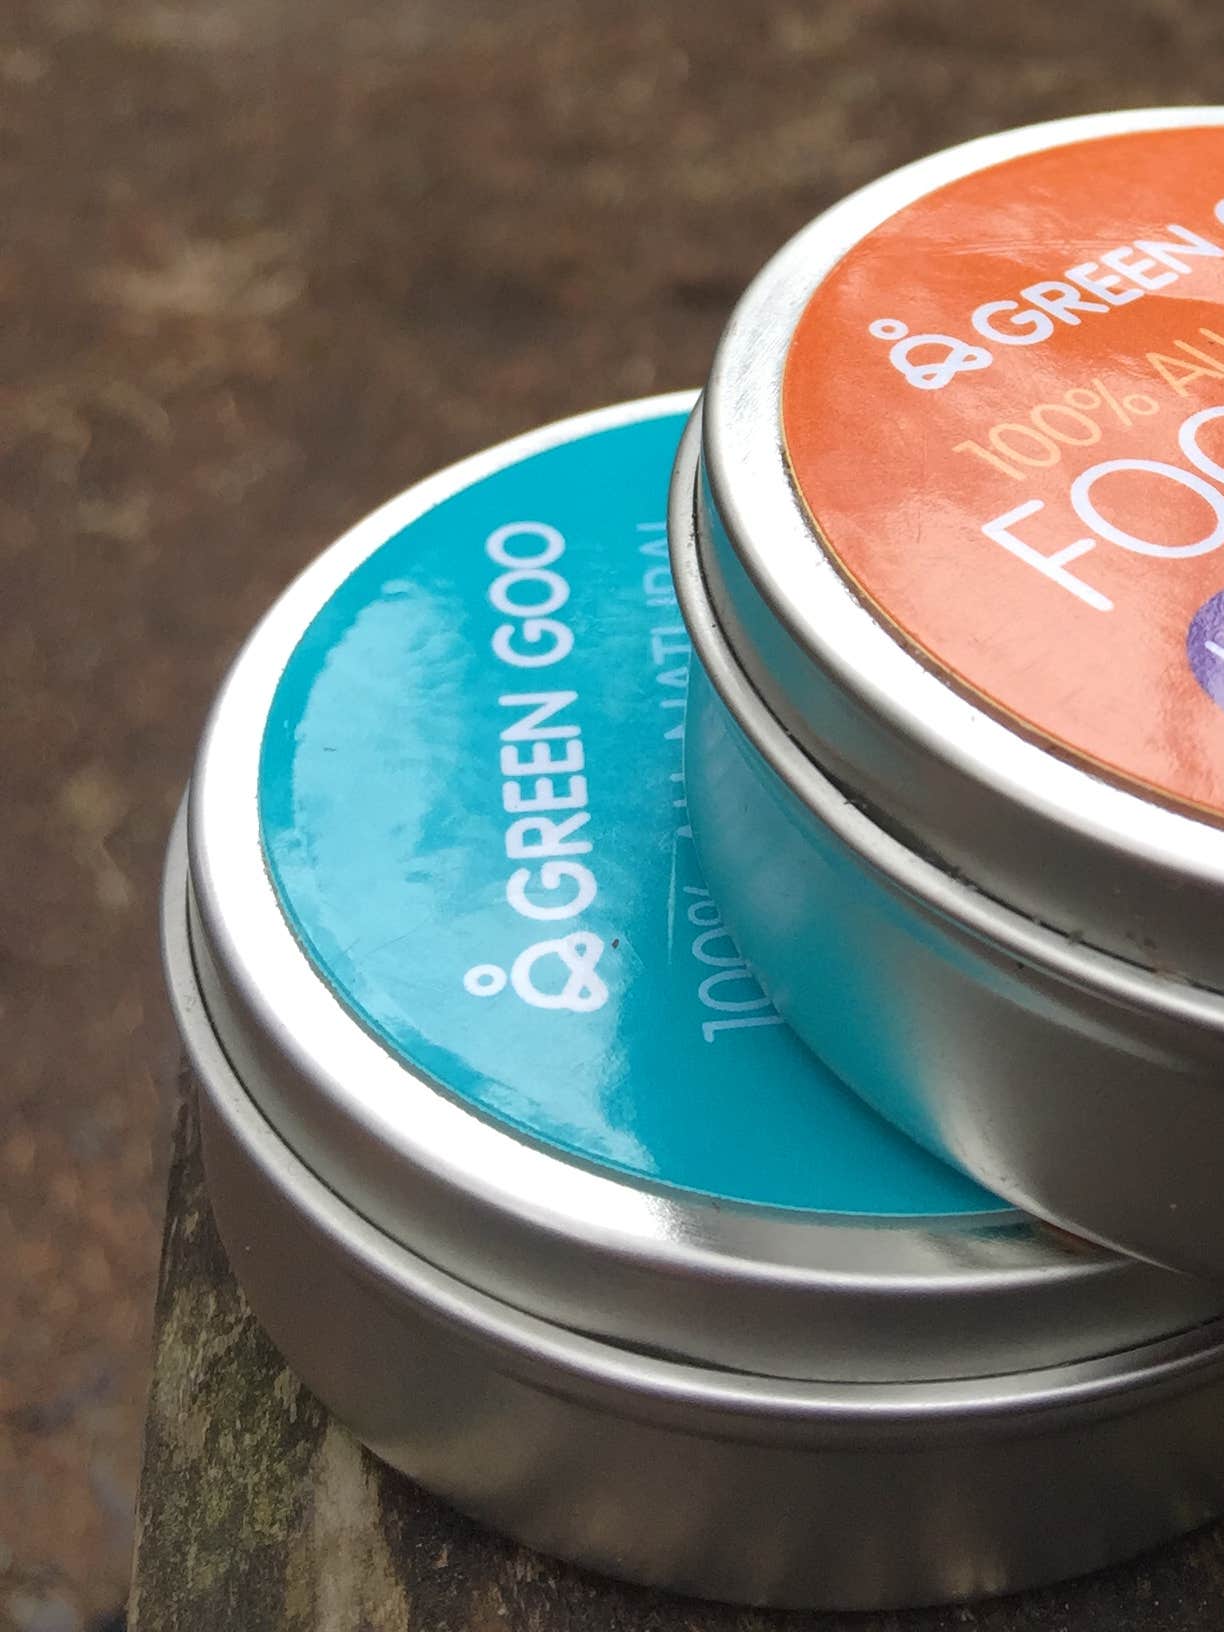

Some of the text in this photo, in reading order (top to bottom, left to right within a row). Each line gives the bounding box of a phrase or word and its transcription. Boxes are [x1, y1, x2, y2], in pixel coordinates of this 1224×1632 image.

[952, 378, 1159, 482] 100%
[485, 520, 598, 921] GREEN GOO
